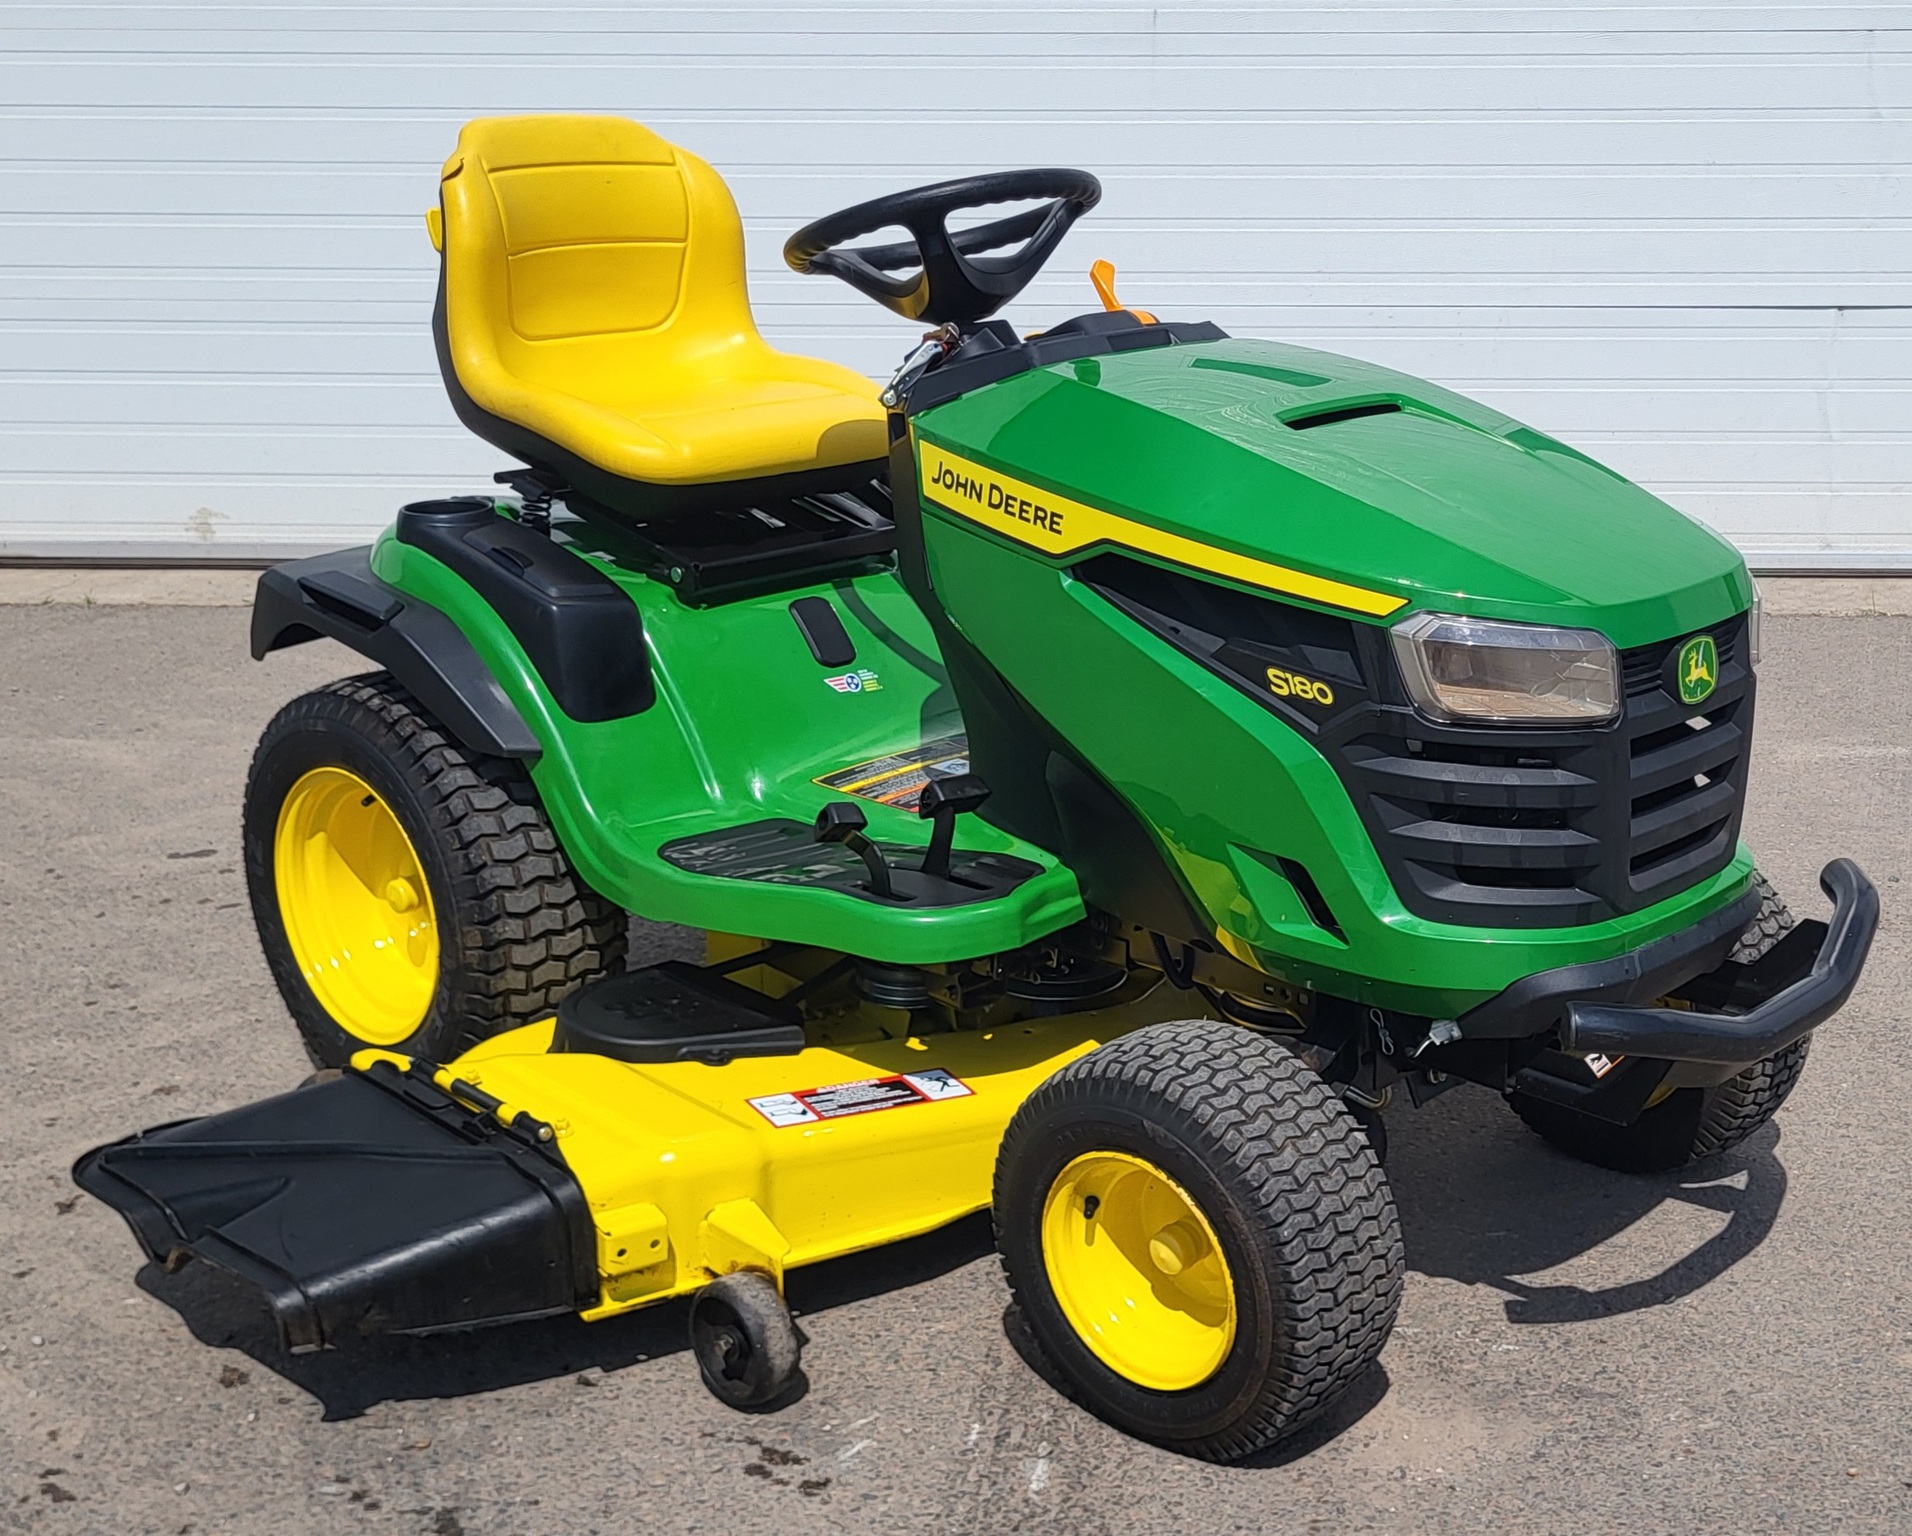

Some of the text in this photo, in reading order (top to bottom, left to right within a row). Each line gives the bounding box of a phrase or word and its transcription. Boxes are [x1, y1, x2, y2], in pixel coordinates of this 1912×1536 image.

[931, 460, 1064, 536] JOHN DEERE
[1266, 668, 1334, 705] S180
